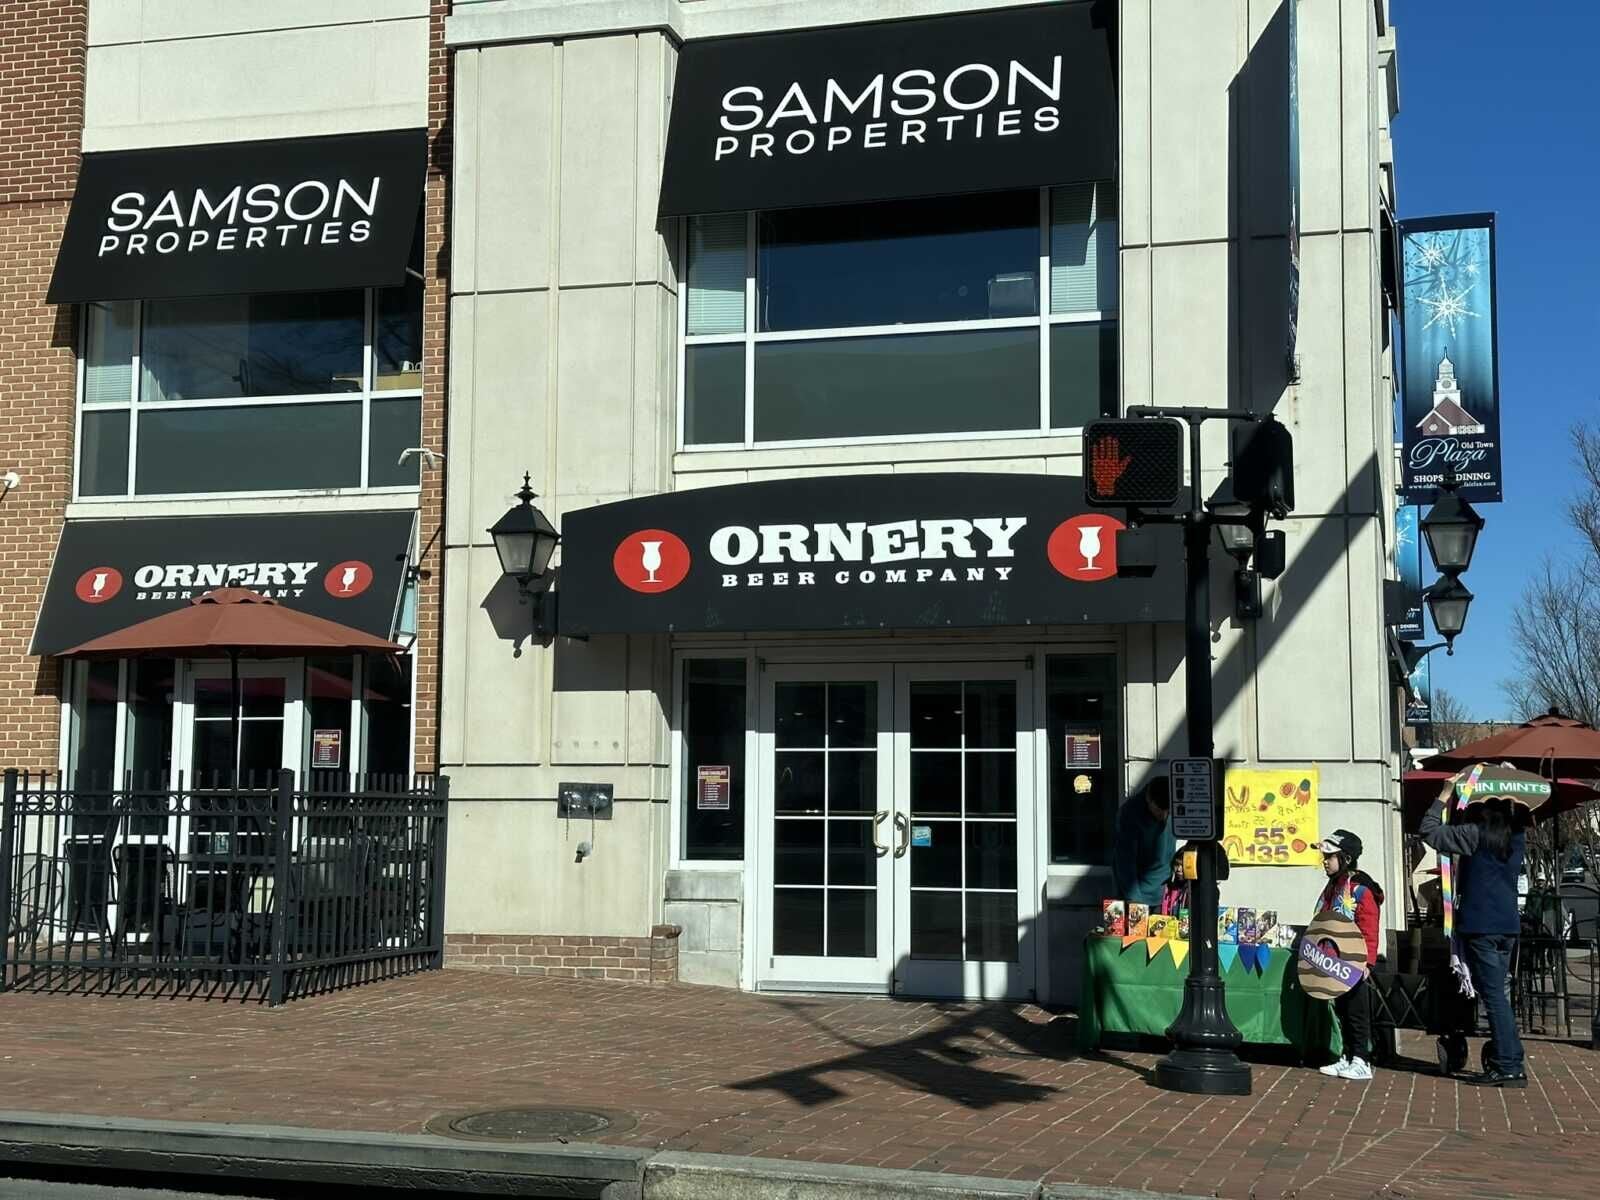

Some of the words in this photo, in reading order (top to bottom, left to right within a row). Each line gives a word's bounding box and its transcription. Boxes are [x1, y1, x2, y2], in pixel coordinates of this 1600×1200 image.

[719, 55, 1062, 132] SAMSON
[714, 106, 1060, 161] PROPERTIES
[107, 176, 380, 232] SAMSON
[98, 219, 371, 257] PROPERTIES
[1409, 437, 1487, 472] Plaza
[1413, 474, 1444, 483] SHOPS
[1455, 472, 1491, 481] DINING
[709, 517, 1028, 566] ORNERY
[134, 562, 319, 588] ORNERY
[722, 572, 816, 588] BEER
[834, 567, 1013, 585] COMPANY
[136, 591, 192, 600] BEER
[1500, 782, 1551, 792] MINTS
[1254, 828, 1285, 845] 55
[1246, 844, 1289, 863] 135
[1303, 943, 1352, 980] SAMOAS
